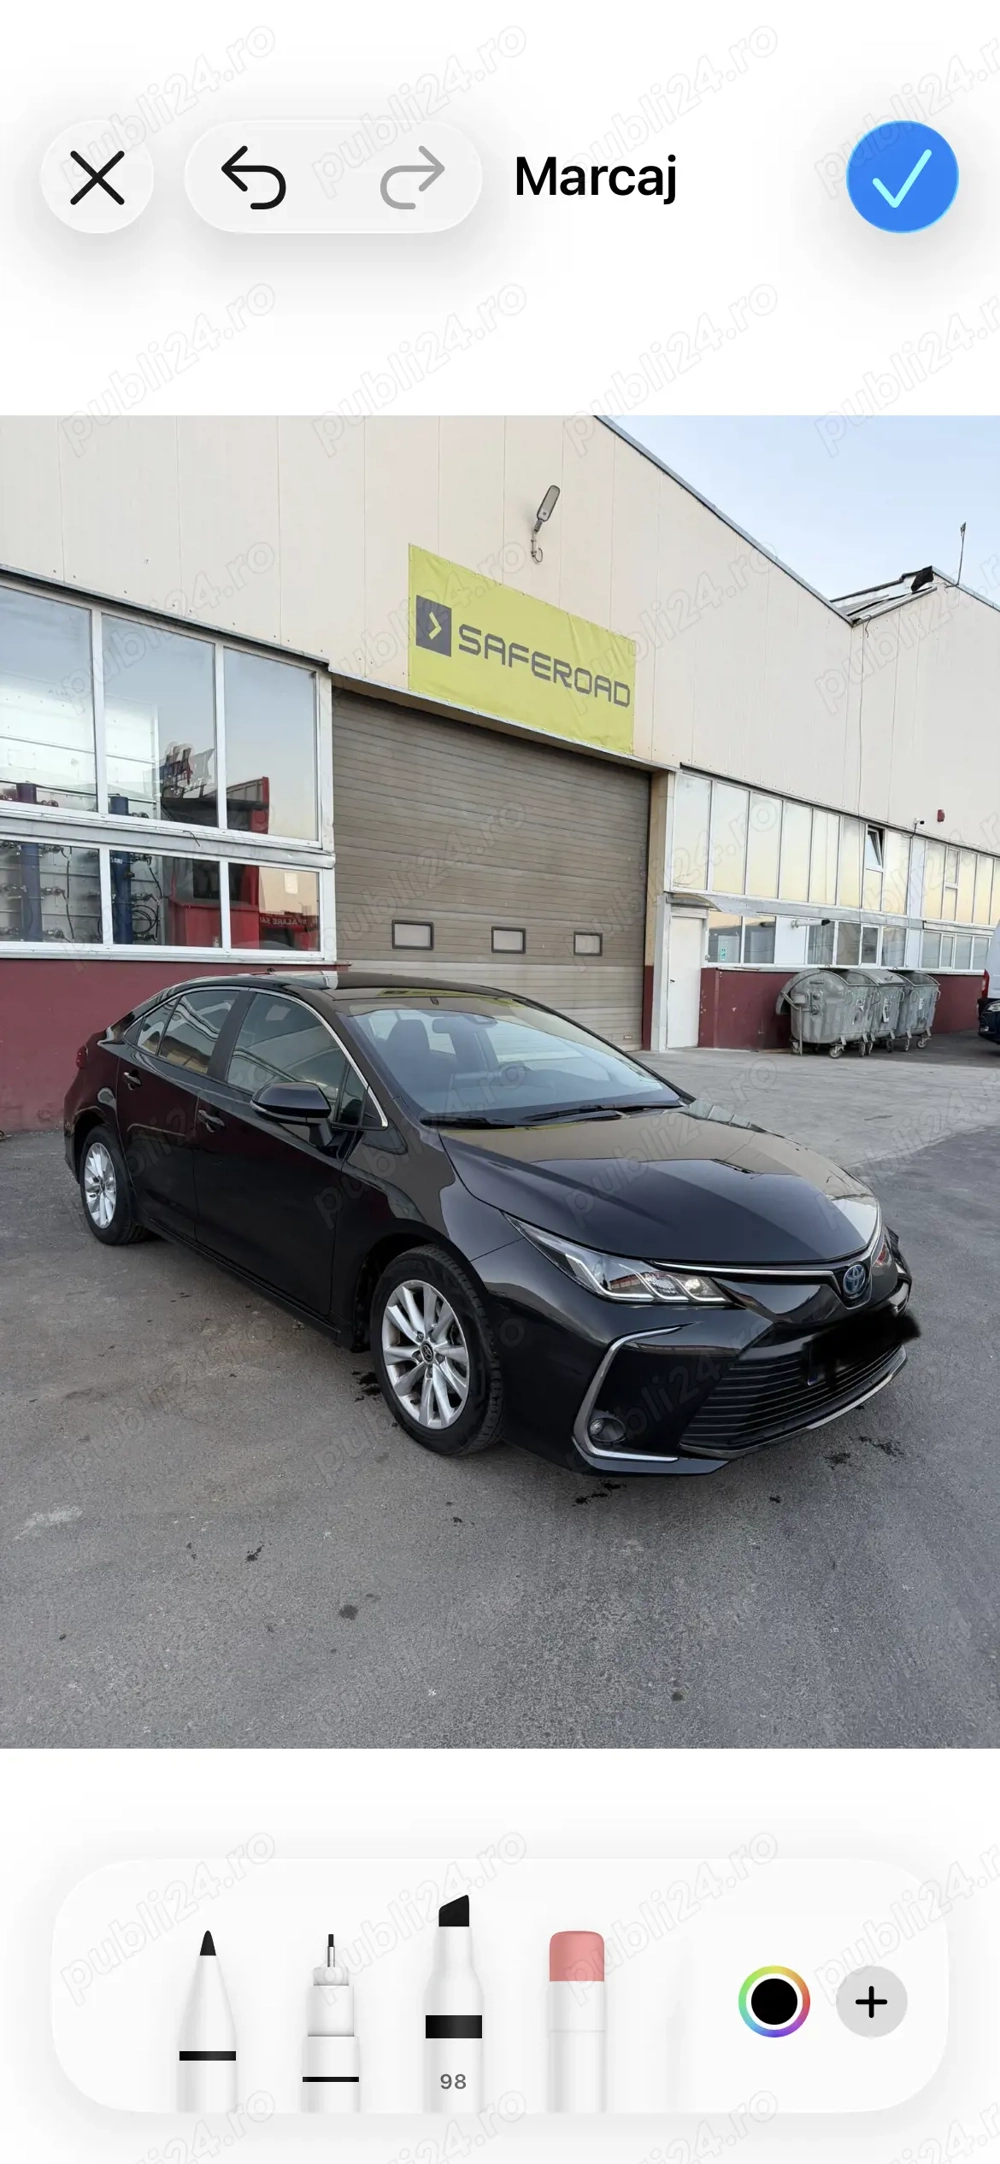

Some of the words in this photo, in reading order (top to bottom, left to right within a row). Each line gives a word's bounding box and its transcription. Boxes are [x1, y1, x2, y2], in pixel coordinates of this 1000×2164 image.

[515, 154, 677, 205] Marcaj
[458, 623, 631, 708] SAFEROAD
[440, 2073, 467, 2090] 98
